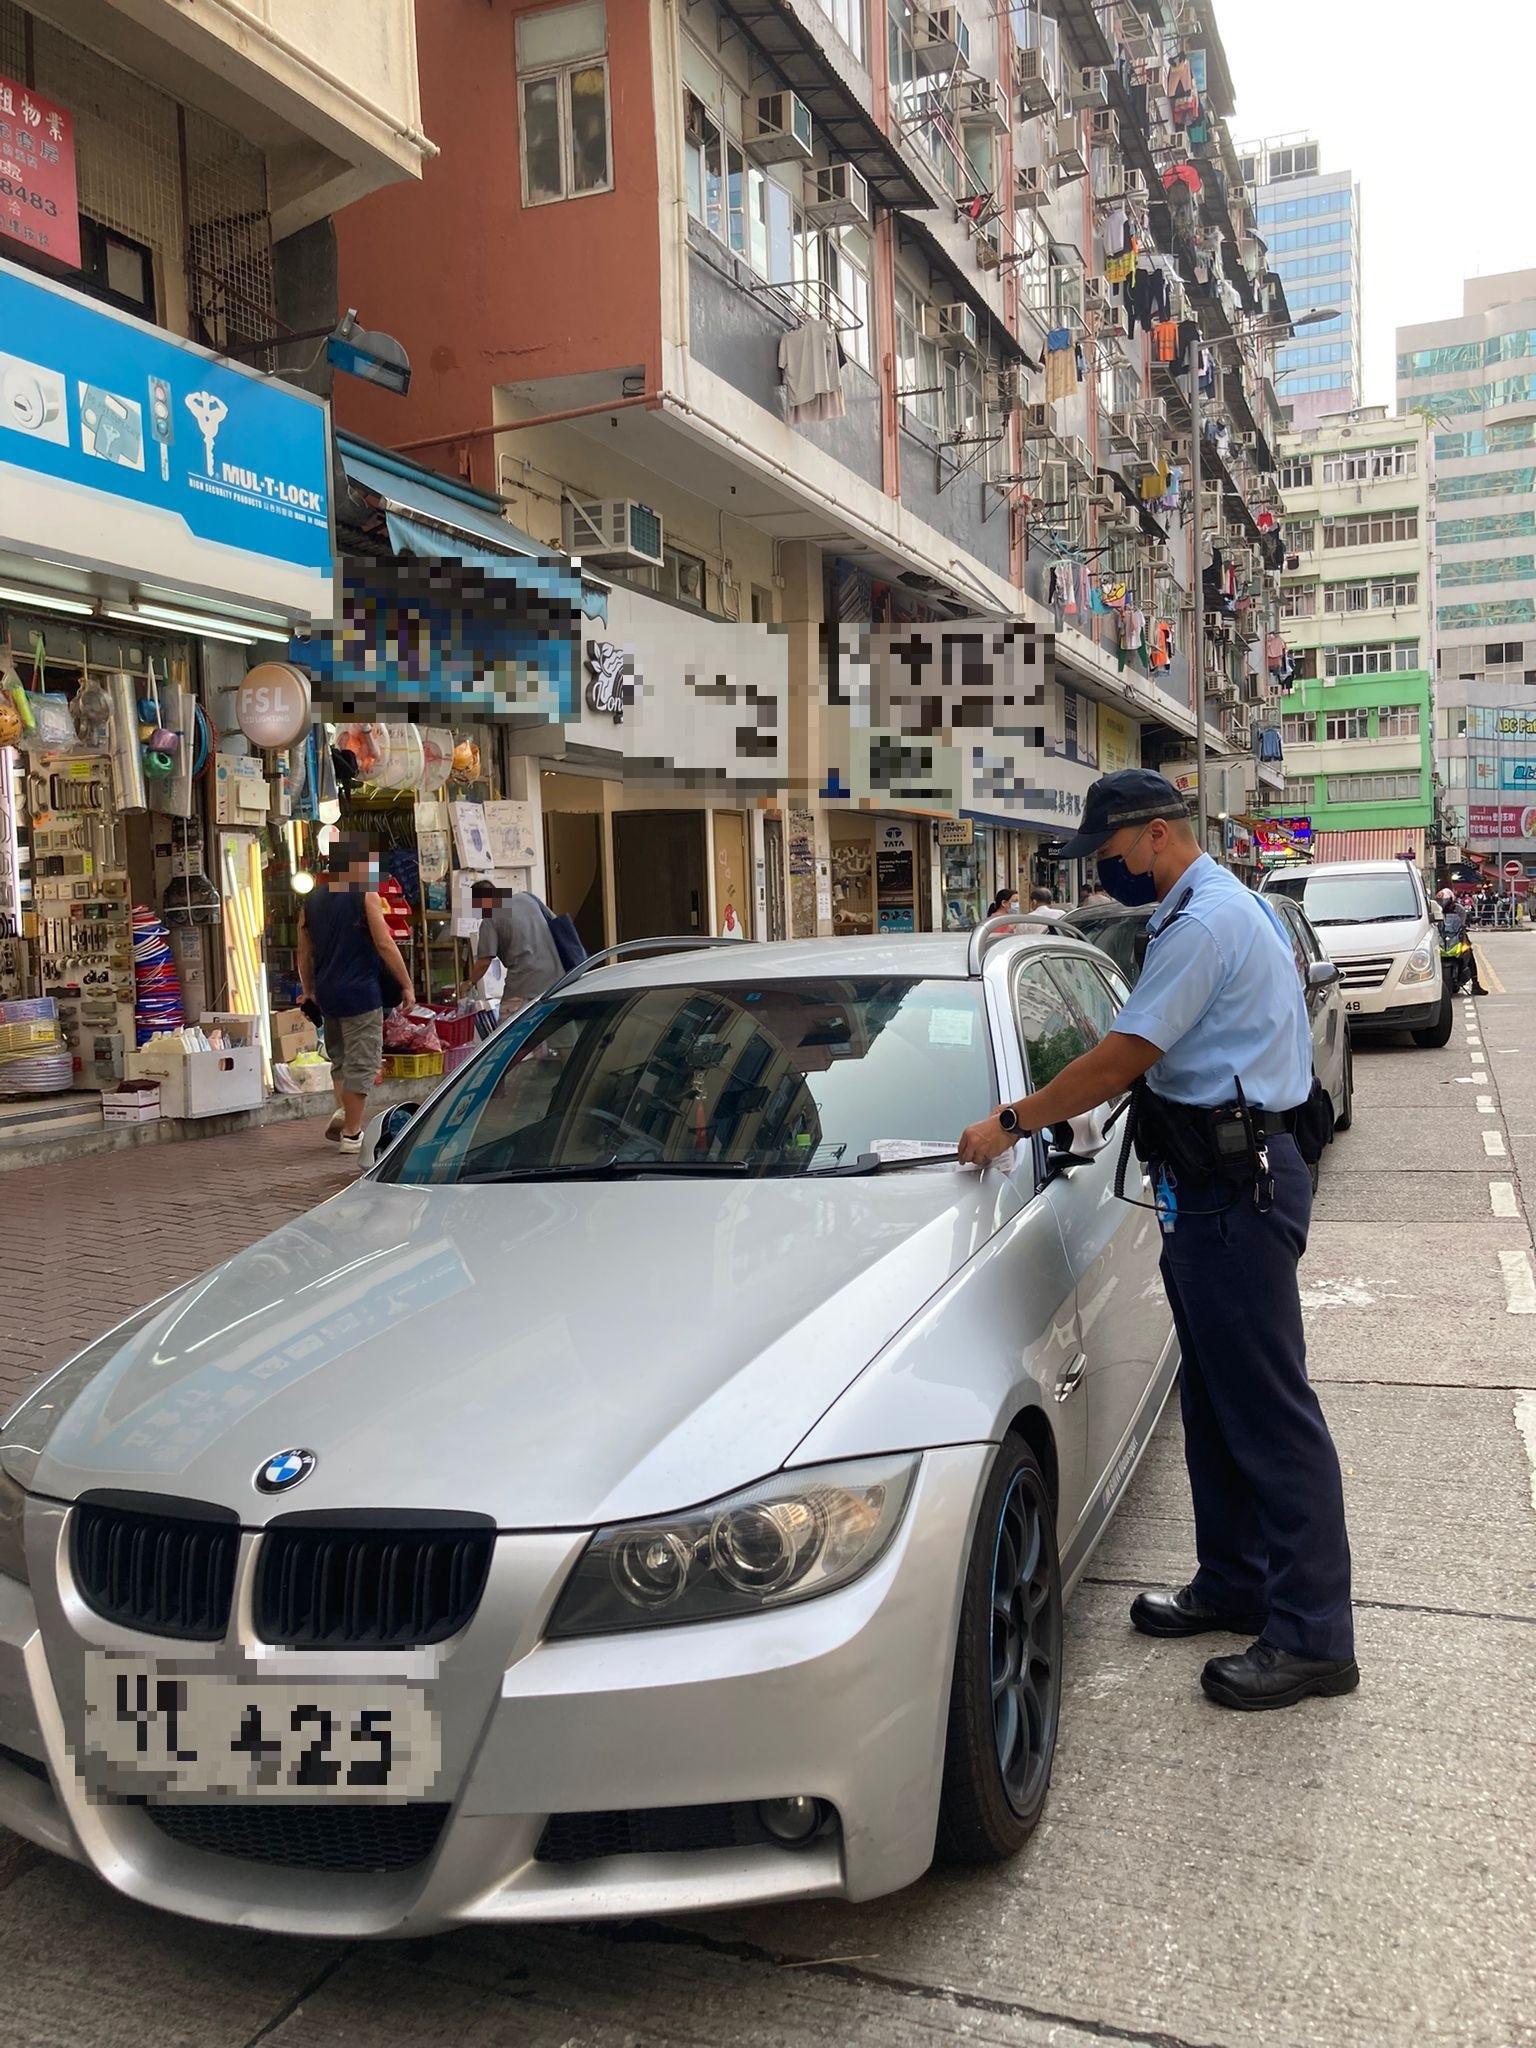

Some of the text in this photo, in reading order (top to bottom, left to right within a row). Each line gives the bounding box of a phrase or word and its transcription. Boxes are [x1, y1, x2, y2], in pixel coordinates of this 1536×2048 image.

[204, 483, 232, 499] SECURITY
[233, 492, 262, 508] PRODUCTS
[242, 687, 289, 713] FSL
[1496, 717, 1517, 732] ABC
[1345, 1001, 1360, 1011] 48
